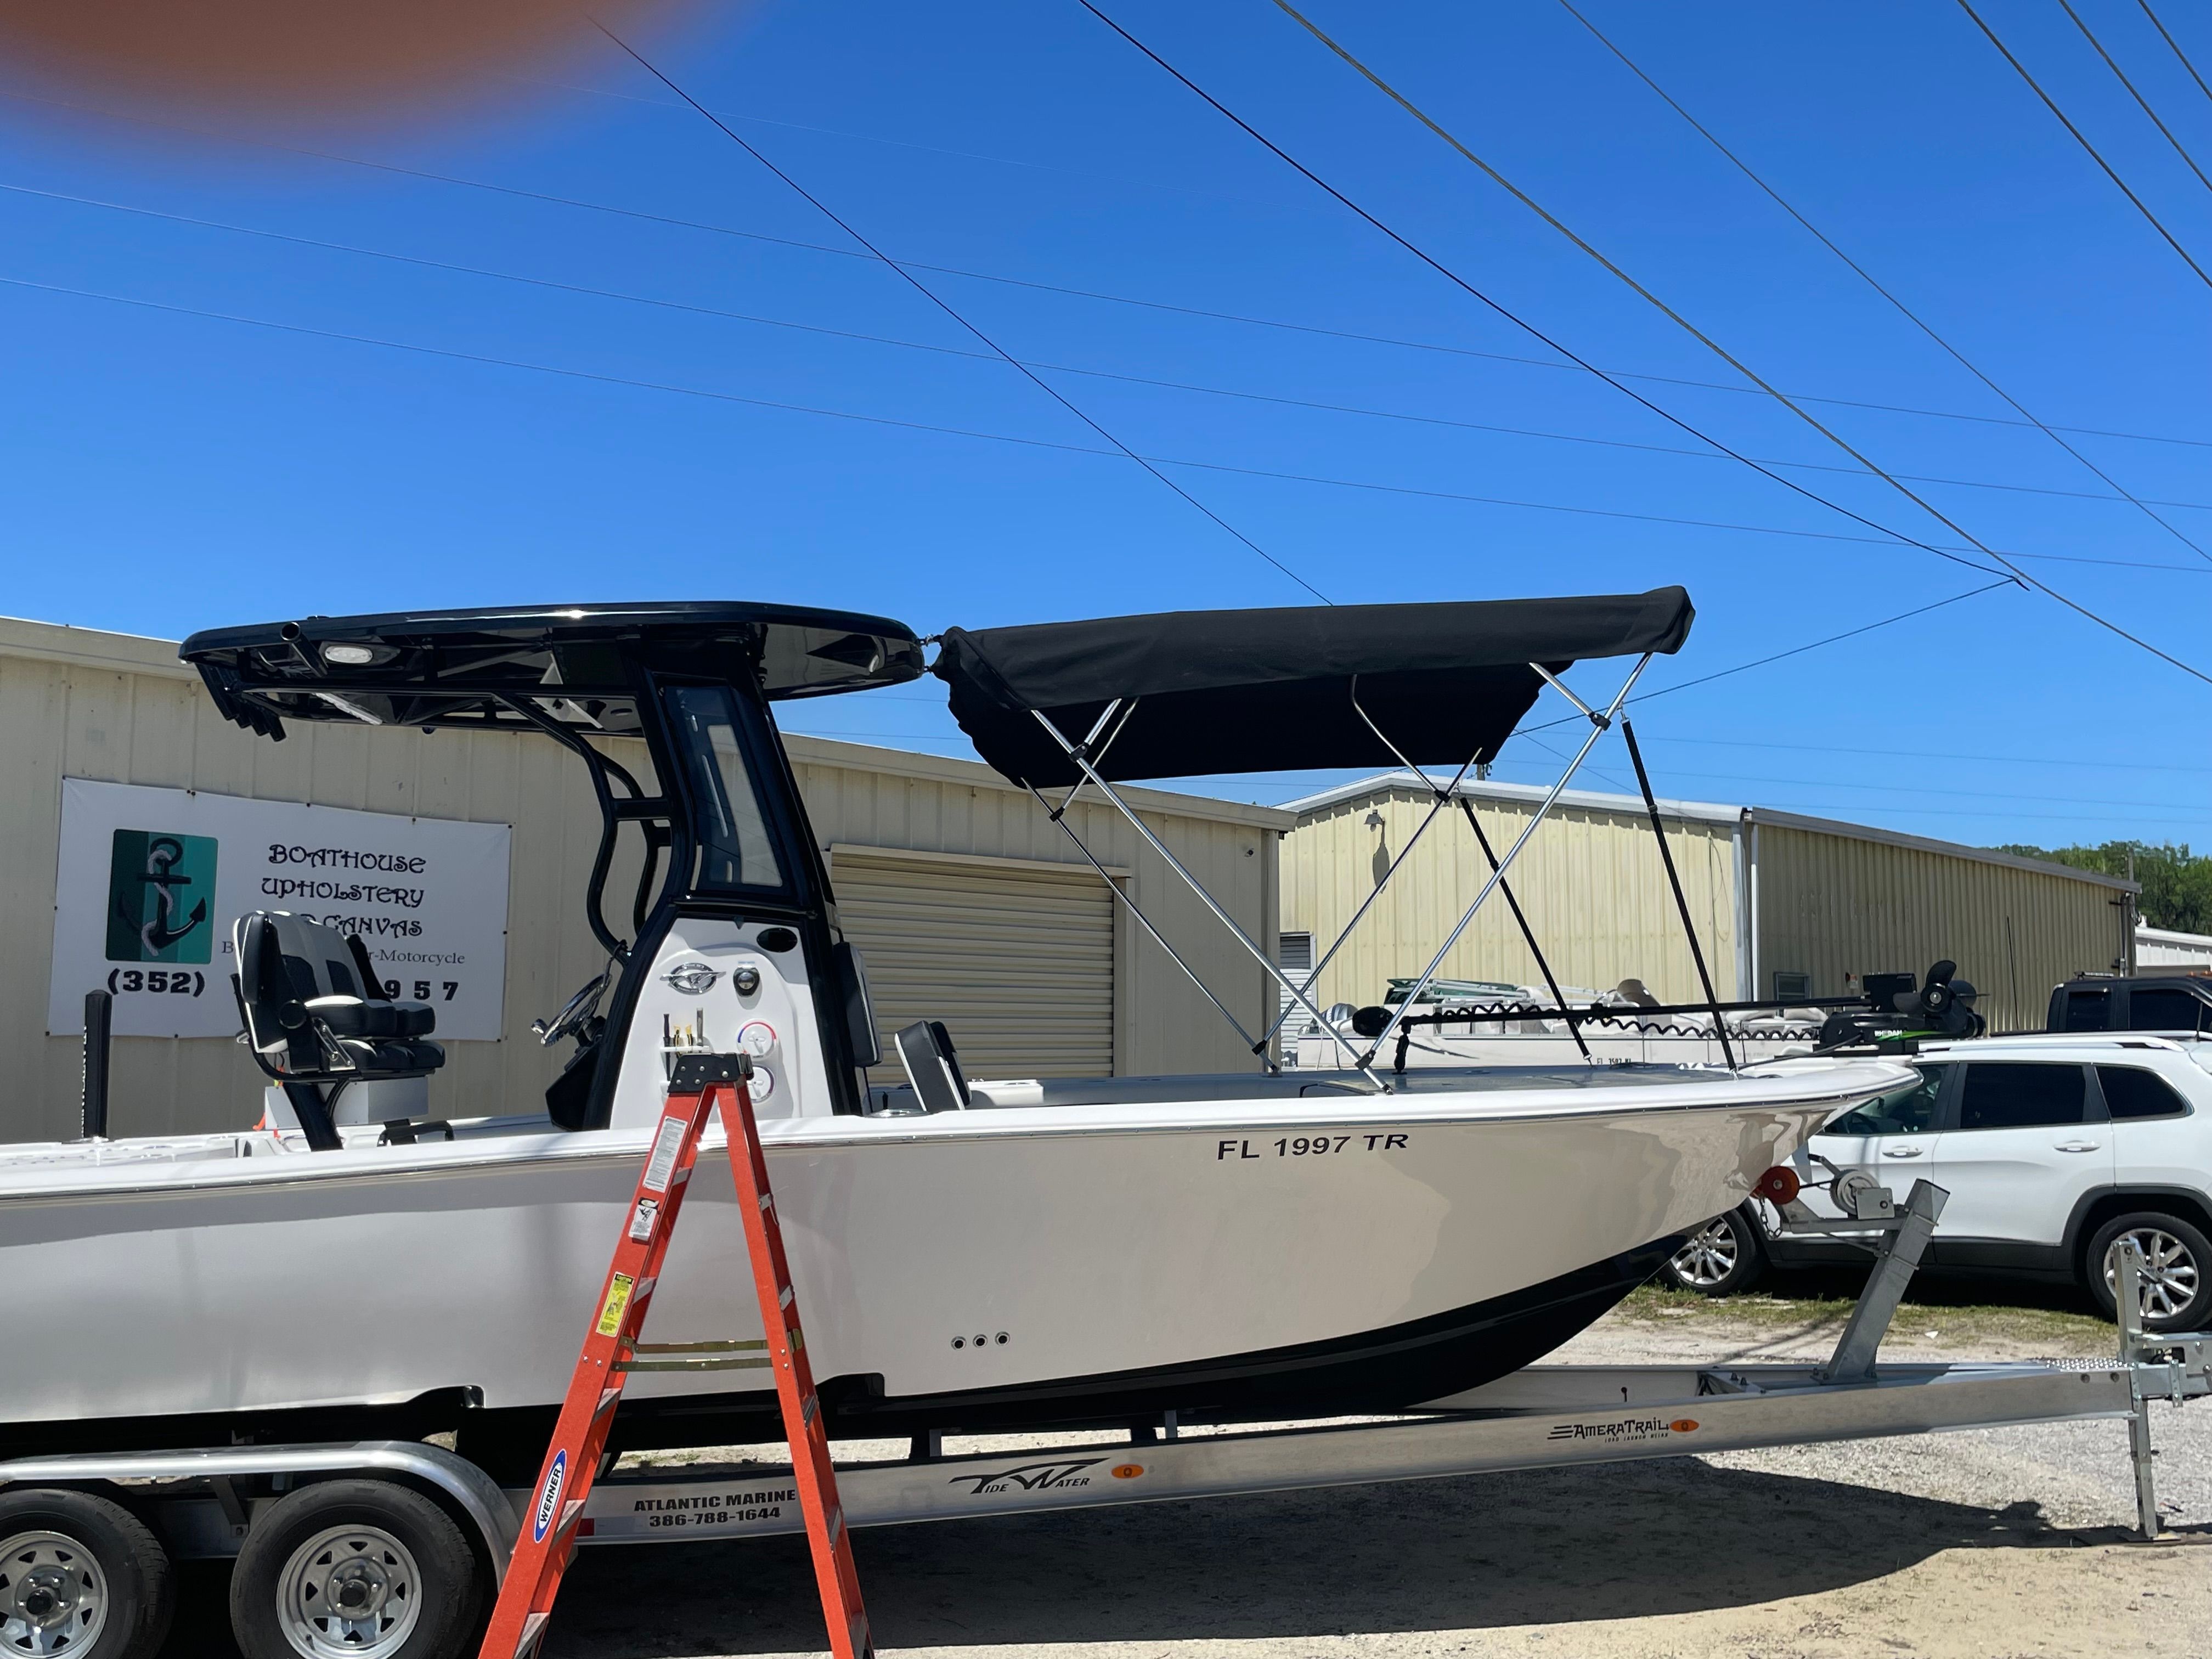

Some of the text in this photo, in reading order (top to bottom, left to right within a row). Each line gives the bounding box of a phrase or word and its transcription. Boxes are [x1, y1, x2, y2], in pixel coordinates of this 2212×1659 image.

[268, 844, 426, 873] BOATHOUSE
[261, 877, 425, 908] UPHOLSTERY
[323, 915, 423, 939] CANVAS
[368, 949, 466, 966] r-Motorcycle
[107, 968, 205, 998] (352)
[1217, 1133, 1409, 1160] FL 1997 TR
[539, 1468, 561, 1522] WERNER
[634, 1489, 796, 1512] ATLANTIC MARINE
[648, 1506, 781, 1527] 386-788-1644
